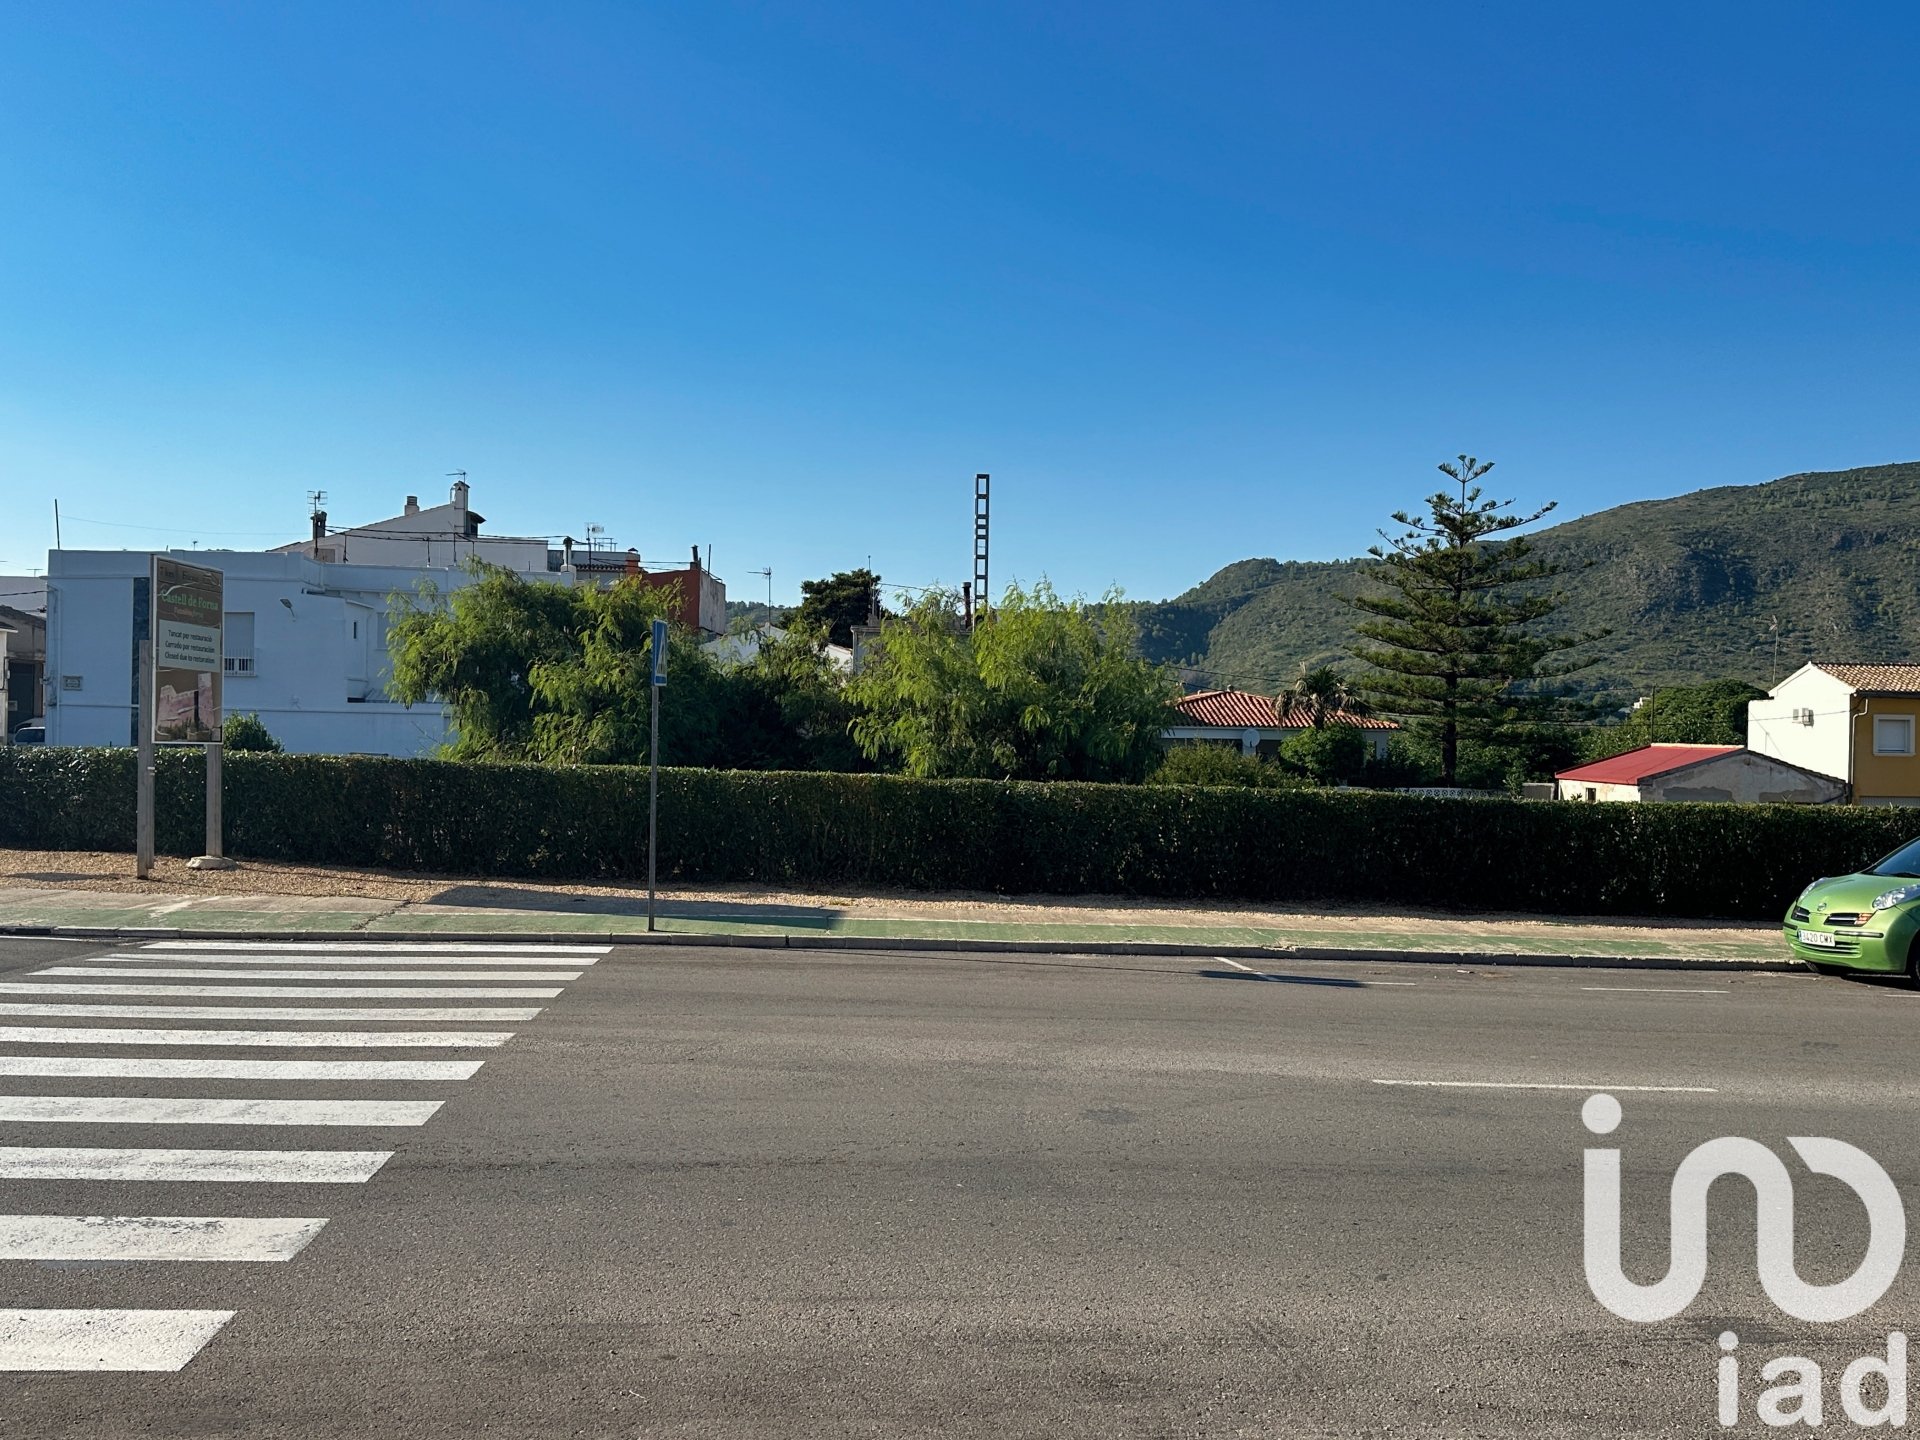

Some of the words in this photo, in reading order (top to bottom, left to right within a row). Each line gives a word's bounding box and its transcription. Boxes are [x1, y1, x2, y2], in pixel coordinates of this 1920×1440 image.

[161, 592, 187, 606] Castell
[188, 594, 197, 607] de
[165, 640, 182, 650] Cerrado
[182, 643, 190, 651] por
[164, 651, 179, 660] Closed
[179, 653, 187, 661] due
